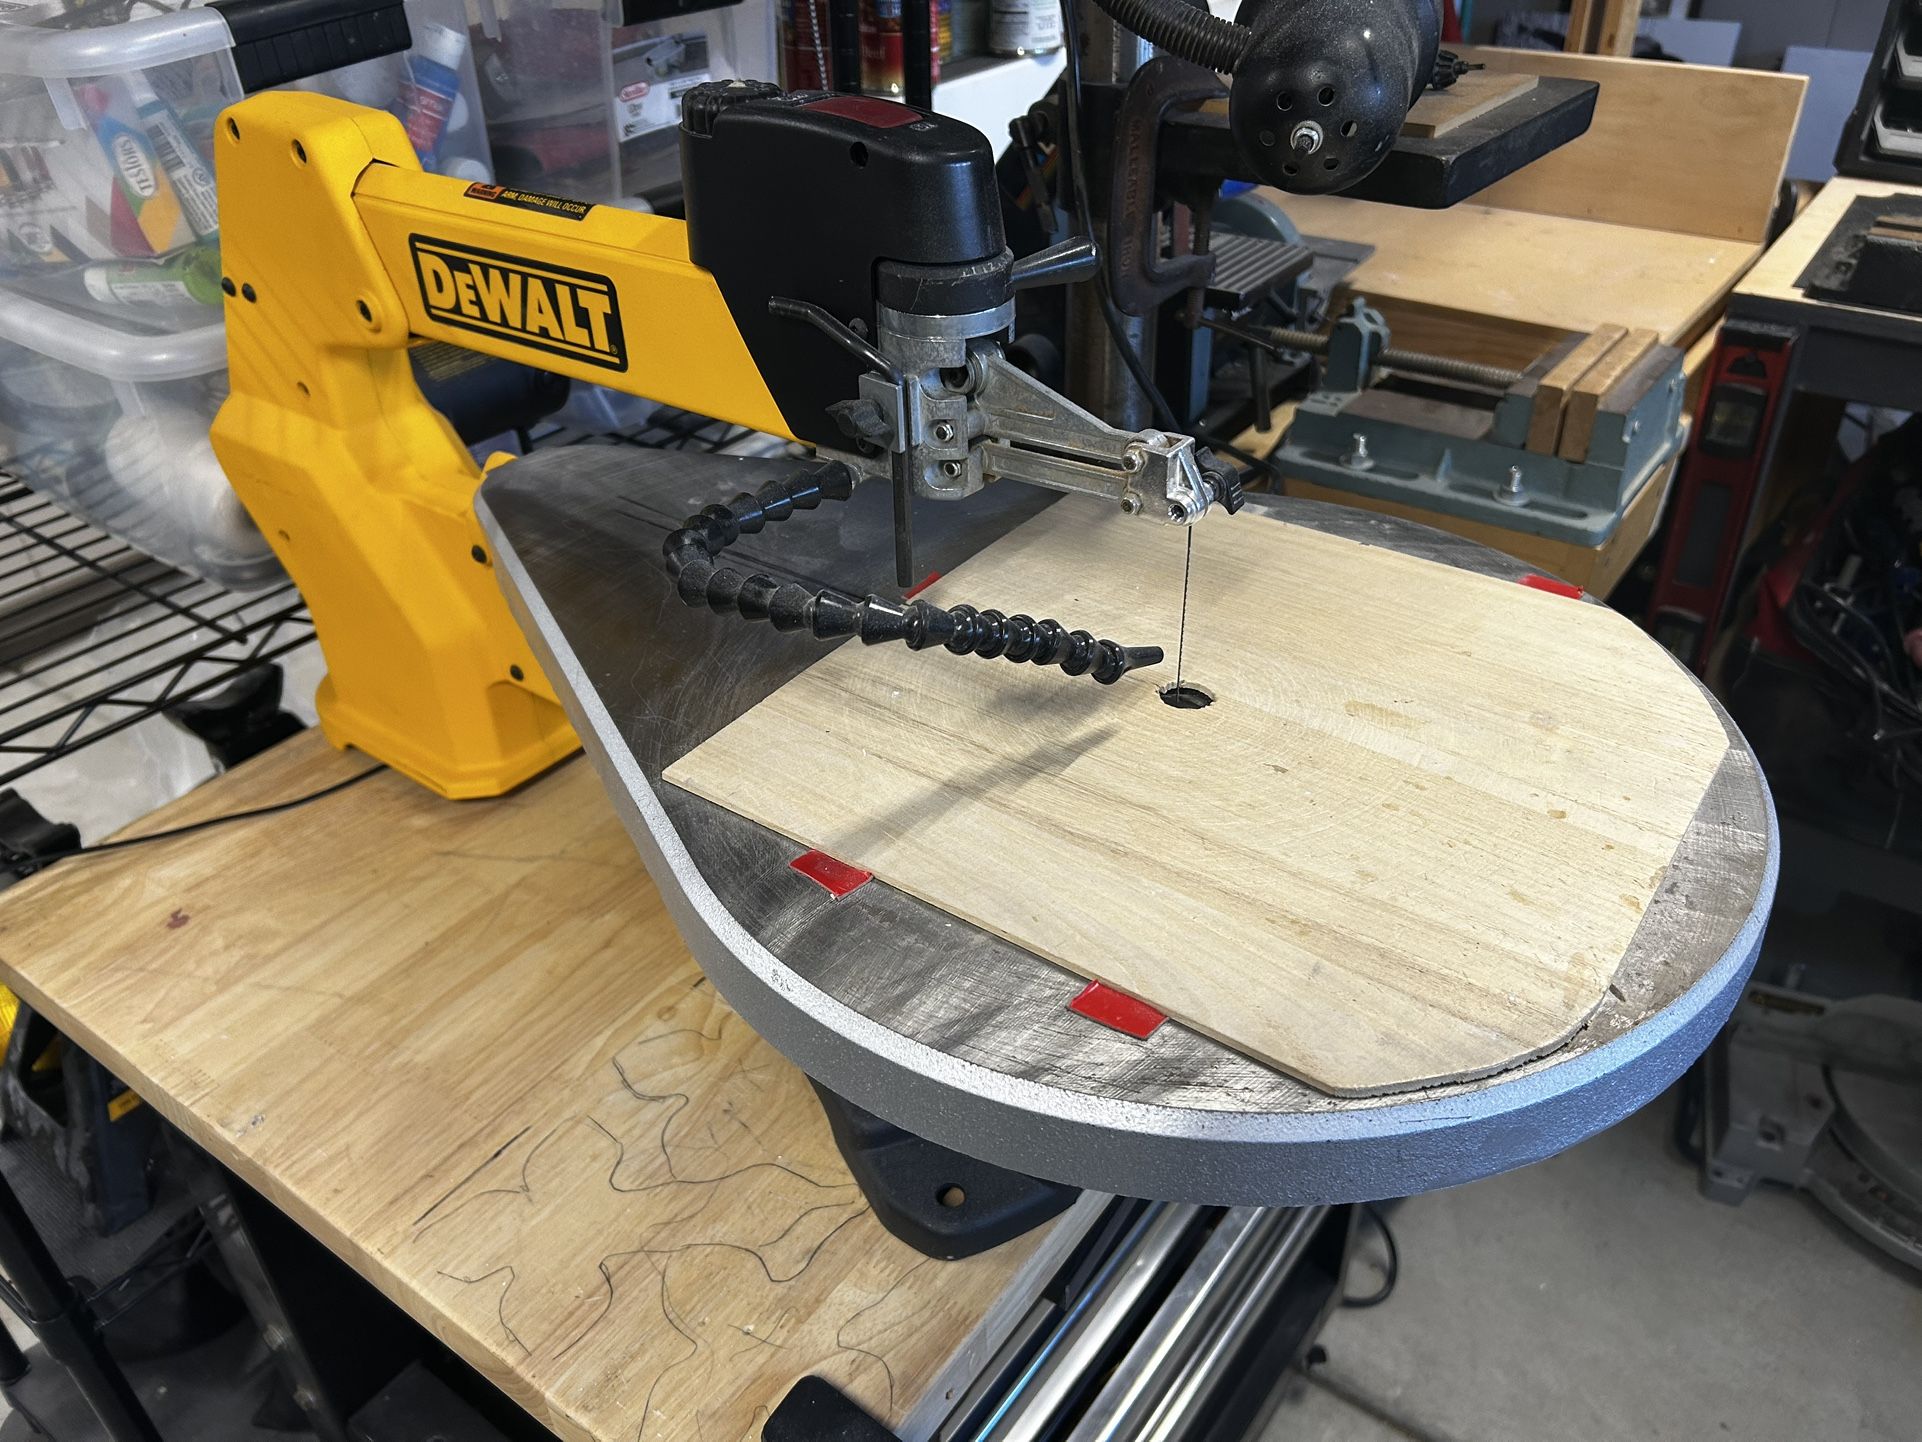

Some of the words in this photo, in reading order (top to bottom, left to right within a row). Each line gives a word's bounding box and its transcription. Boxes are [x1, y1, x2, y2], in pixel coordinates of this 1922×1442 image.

[119, 138, 154, 192] TESTORS
[517, 194, 547, 207] DAMAGE
[545, 198, 562, 210] WILL
[562, 203, 587, 214] OCCUR
[416, 250, 613, 353] DEWALT
